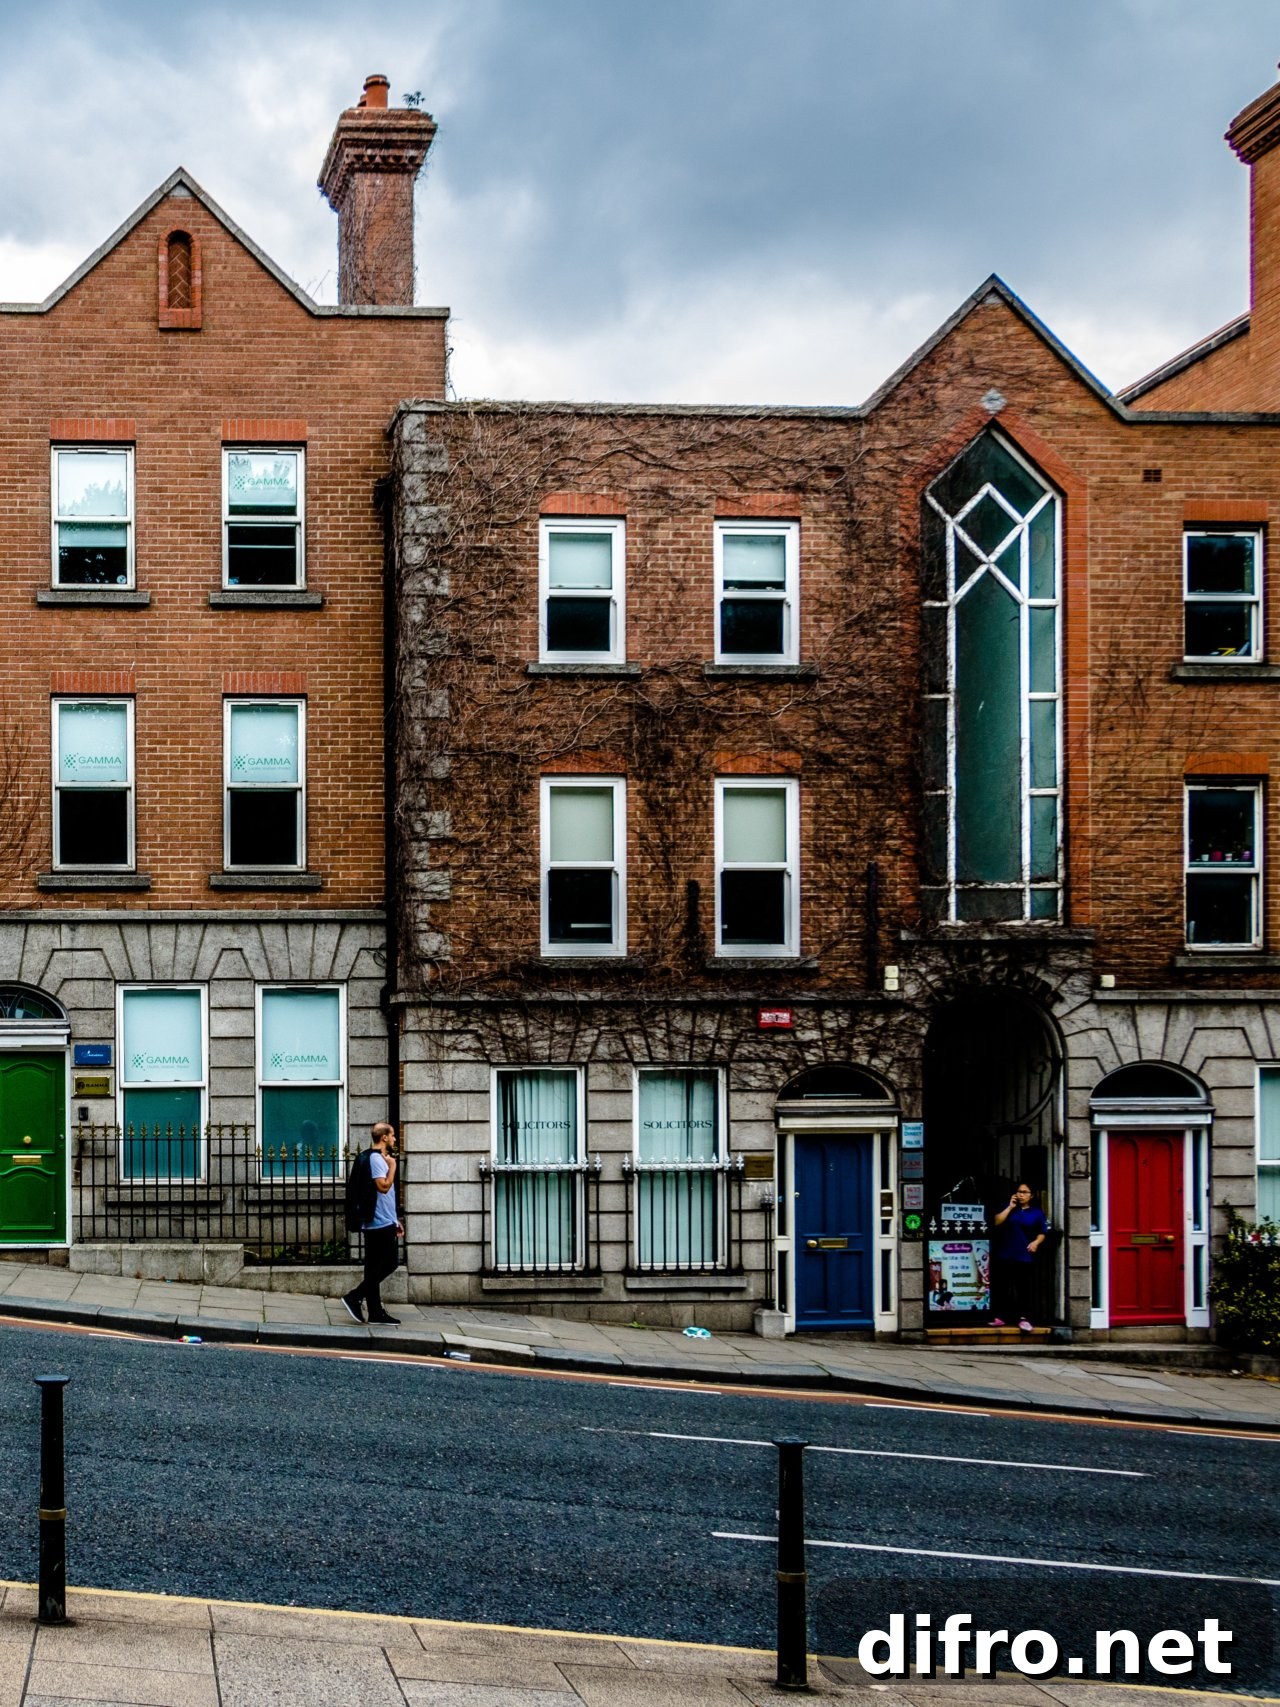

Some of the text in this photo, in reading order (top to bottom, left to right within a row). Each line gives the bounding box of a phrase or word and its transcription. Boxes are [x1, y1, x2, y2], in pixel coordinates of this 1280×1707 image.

[78, 756, 122, 765] GAMMA
[247, 757, 291, 766] GAMMA
[146, 1056, 190, 1064] GAMMA
[284, 1055, 329, 1063] GAMMA
[643, 1120, 713, 1129] SOLICITORS
[952, 1212, 973, 1220] OPEN
